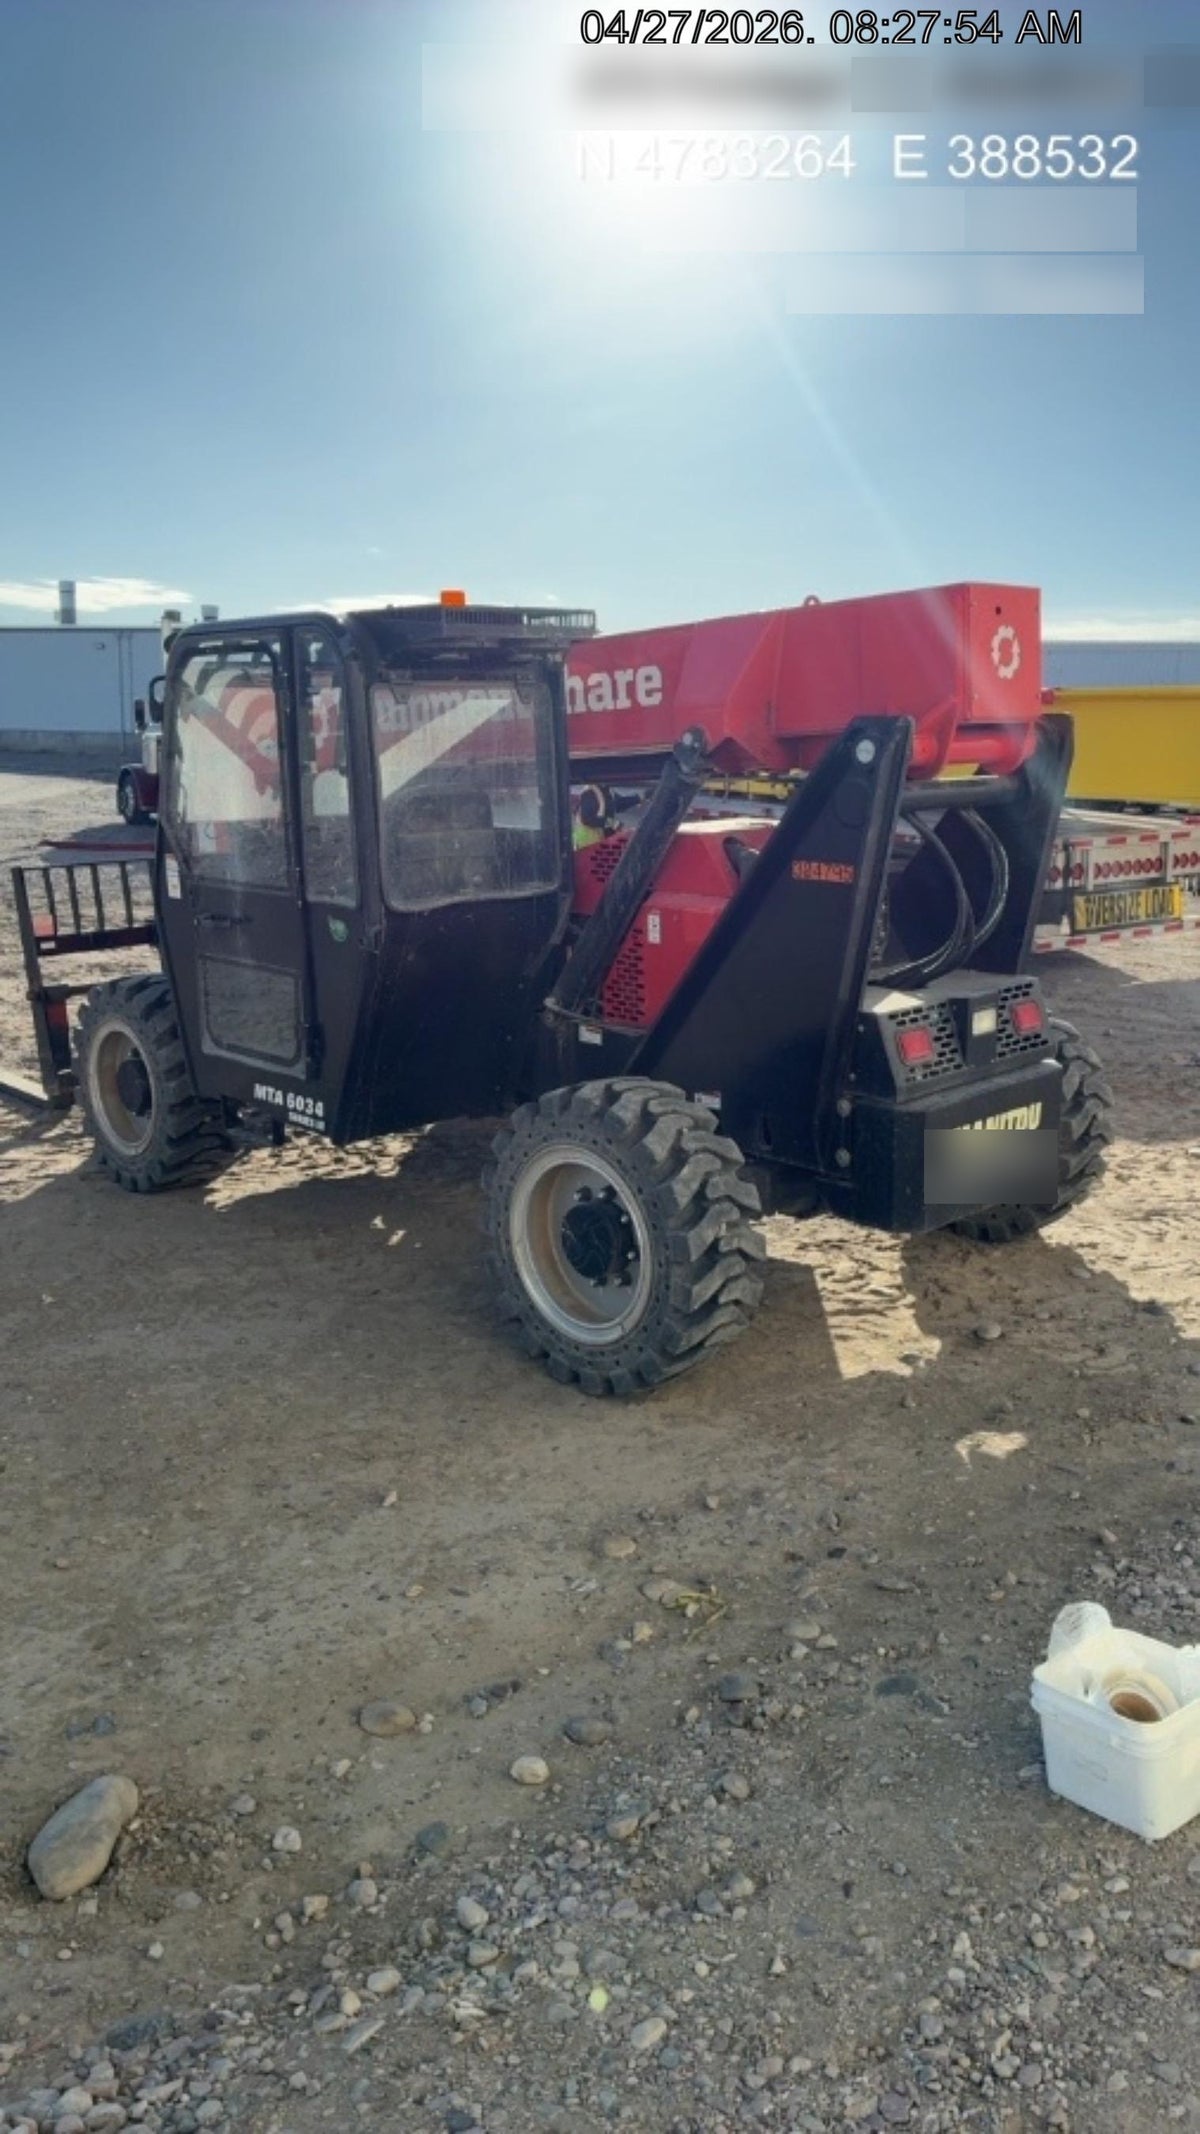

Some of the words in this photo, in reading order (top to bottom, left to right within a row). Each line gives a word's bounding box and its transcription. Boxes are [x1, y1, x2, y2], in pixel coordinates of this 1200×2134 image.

[1085, 890, 1142, 928] OVERSIZE
[1144, 887, 1175, 919] LOAD
[253, 1083, 283, 1106] MTA
[286, 1092, 324, 1117] 6034
